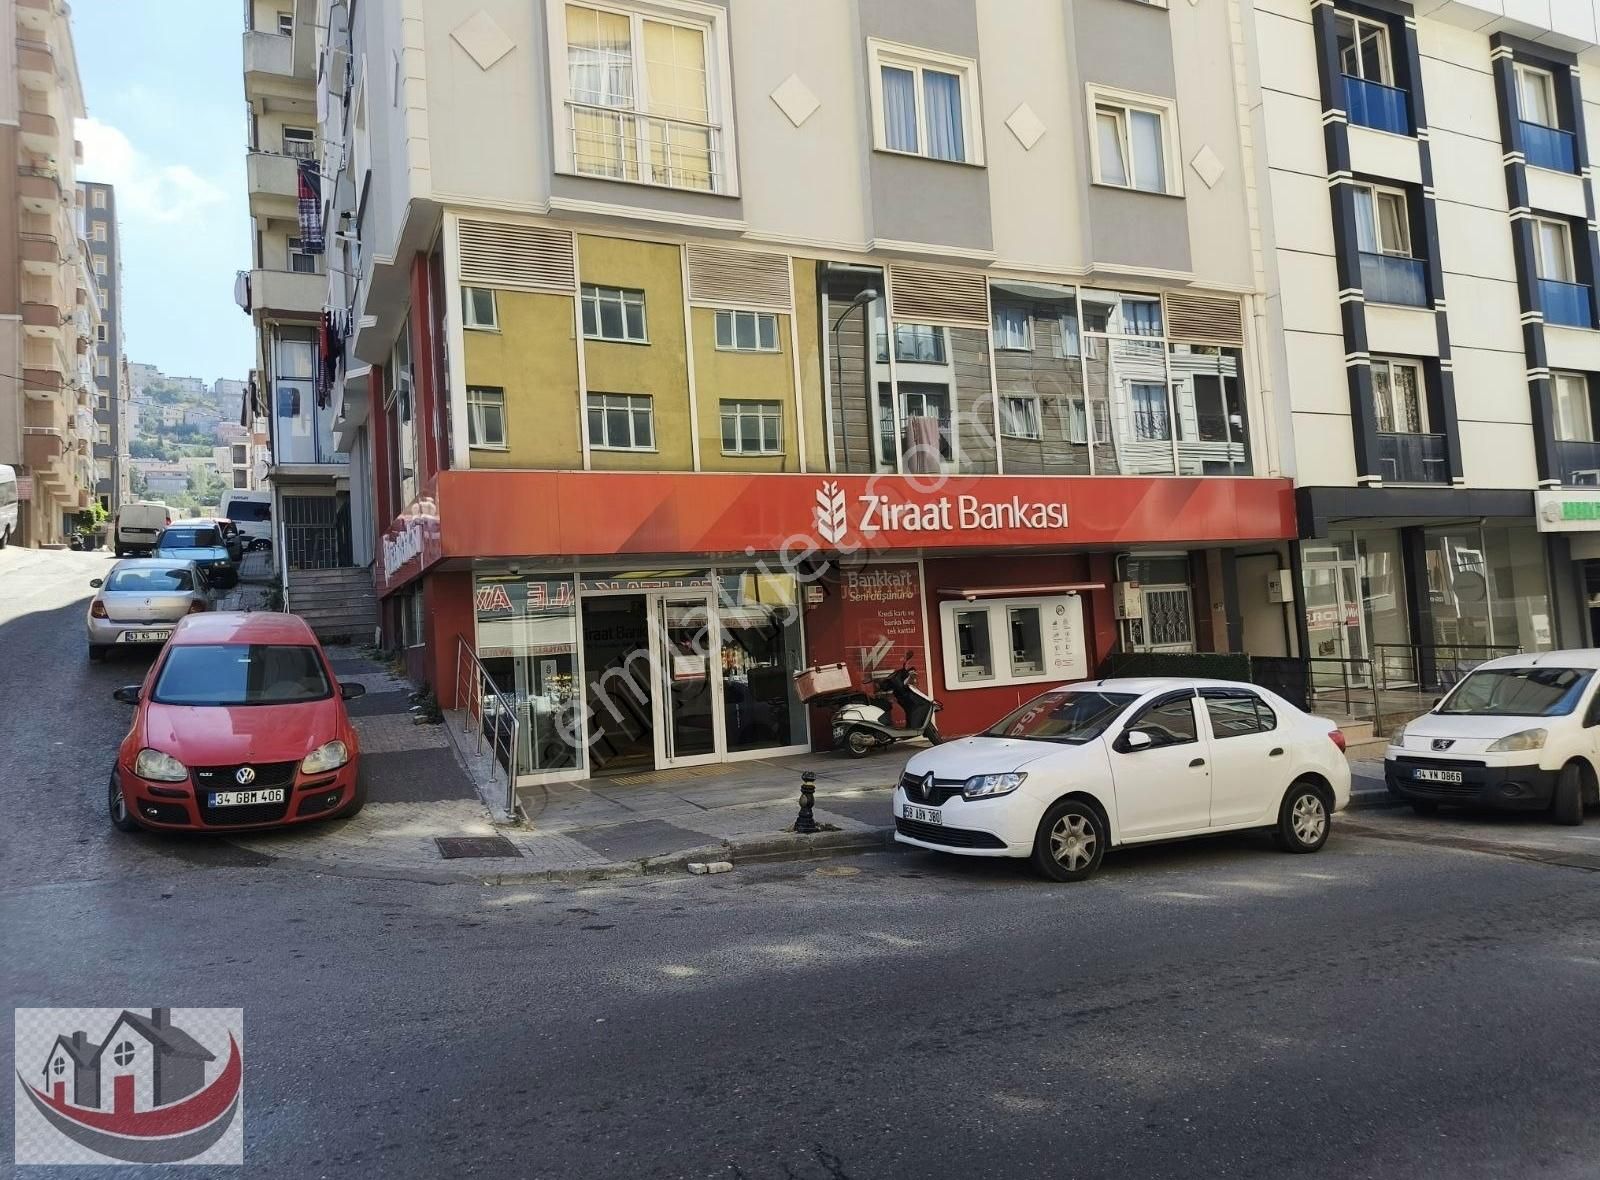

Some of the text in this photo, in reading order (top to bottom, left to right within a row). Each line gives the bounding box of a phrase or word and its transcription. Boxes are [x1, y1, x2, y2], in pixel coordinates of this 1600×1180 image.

[858, 494, 1069, 531] Ziraat Bankası
[847, 570, 913, 588] Bankkart
[216, 790, 282, 805] 34 GBM 406
